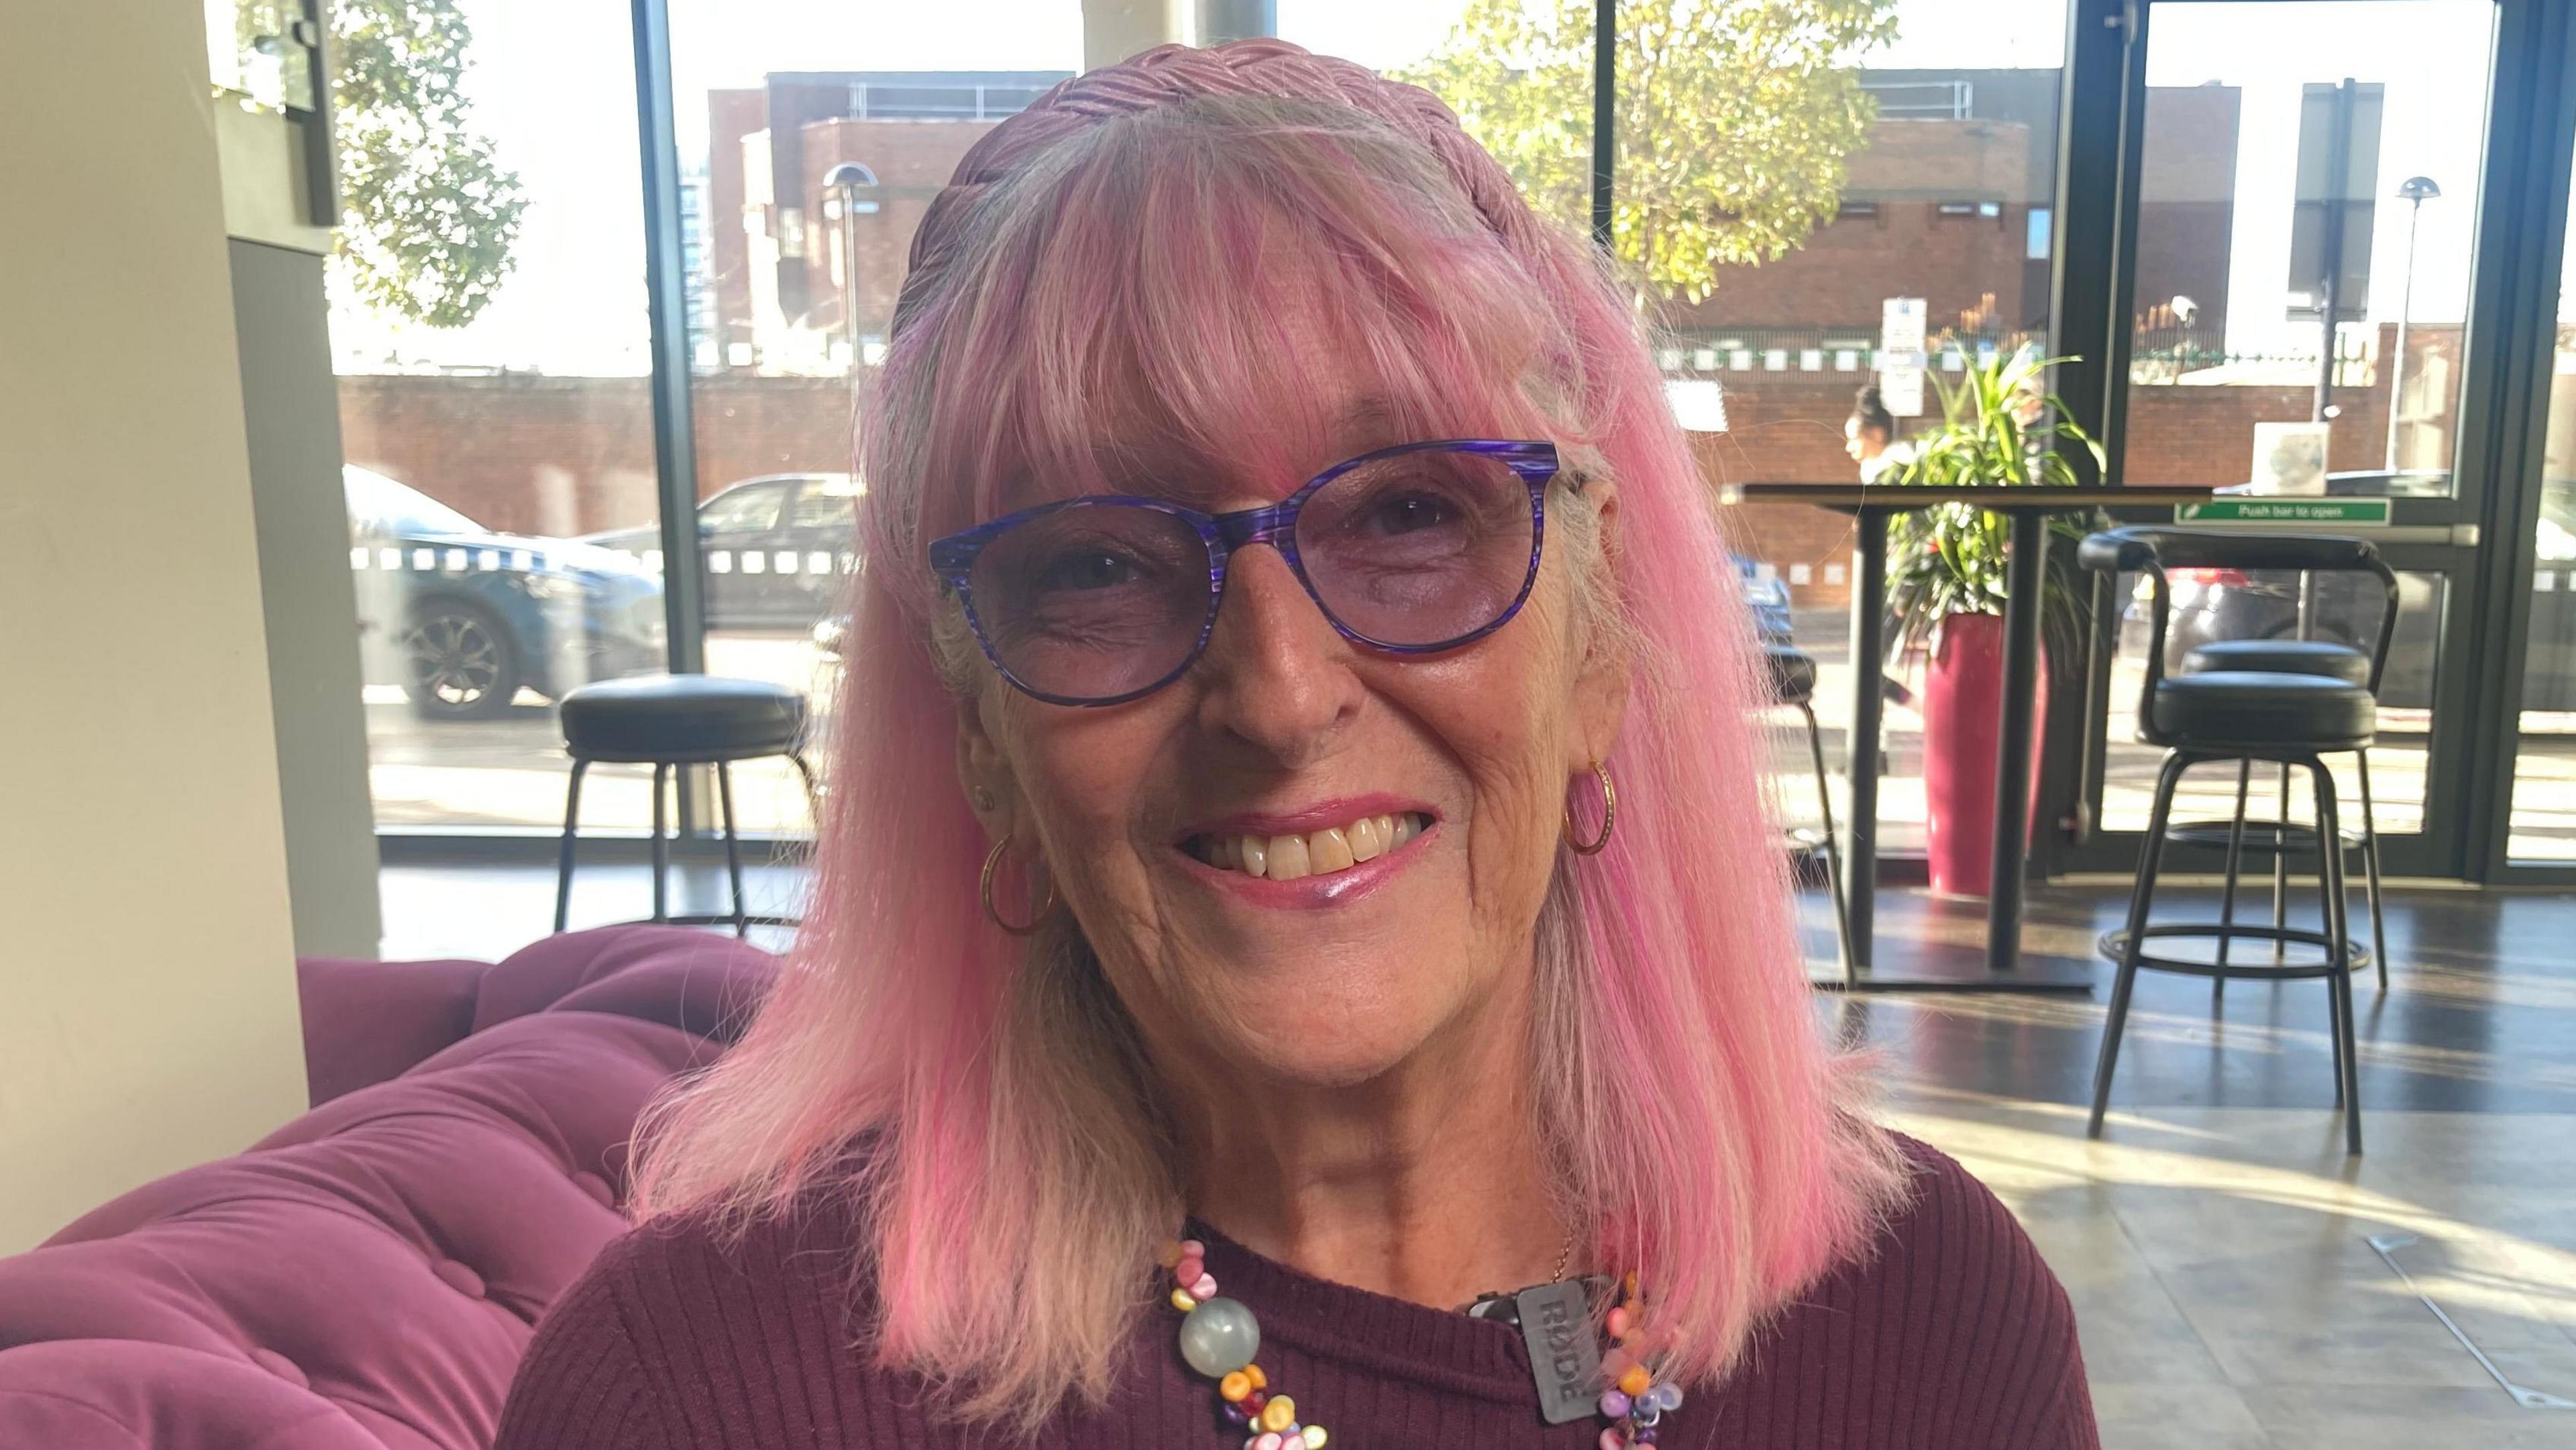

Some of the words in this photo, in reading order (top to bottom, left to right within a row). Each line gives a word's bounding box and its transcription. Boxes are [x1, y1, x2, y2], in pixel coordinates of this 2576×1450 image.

[2238, 504, 2269, 517] Push
[2273, 505, 2294, 517] bar
[2296, 505, 2308, 517] to
[2311, 507, 2343, 519] open
